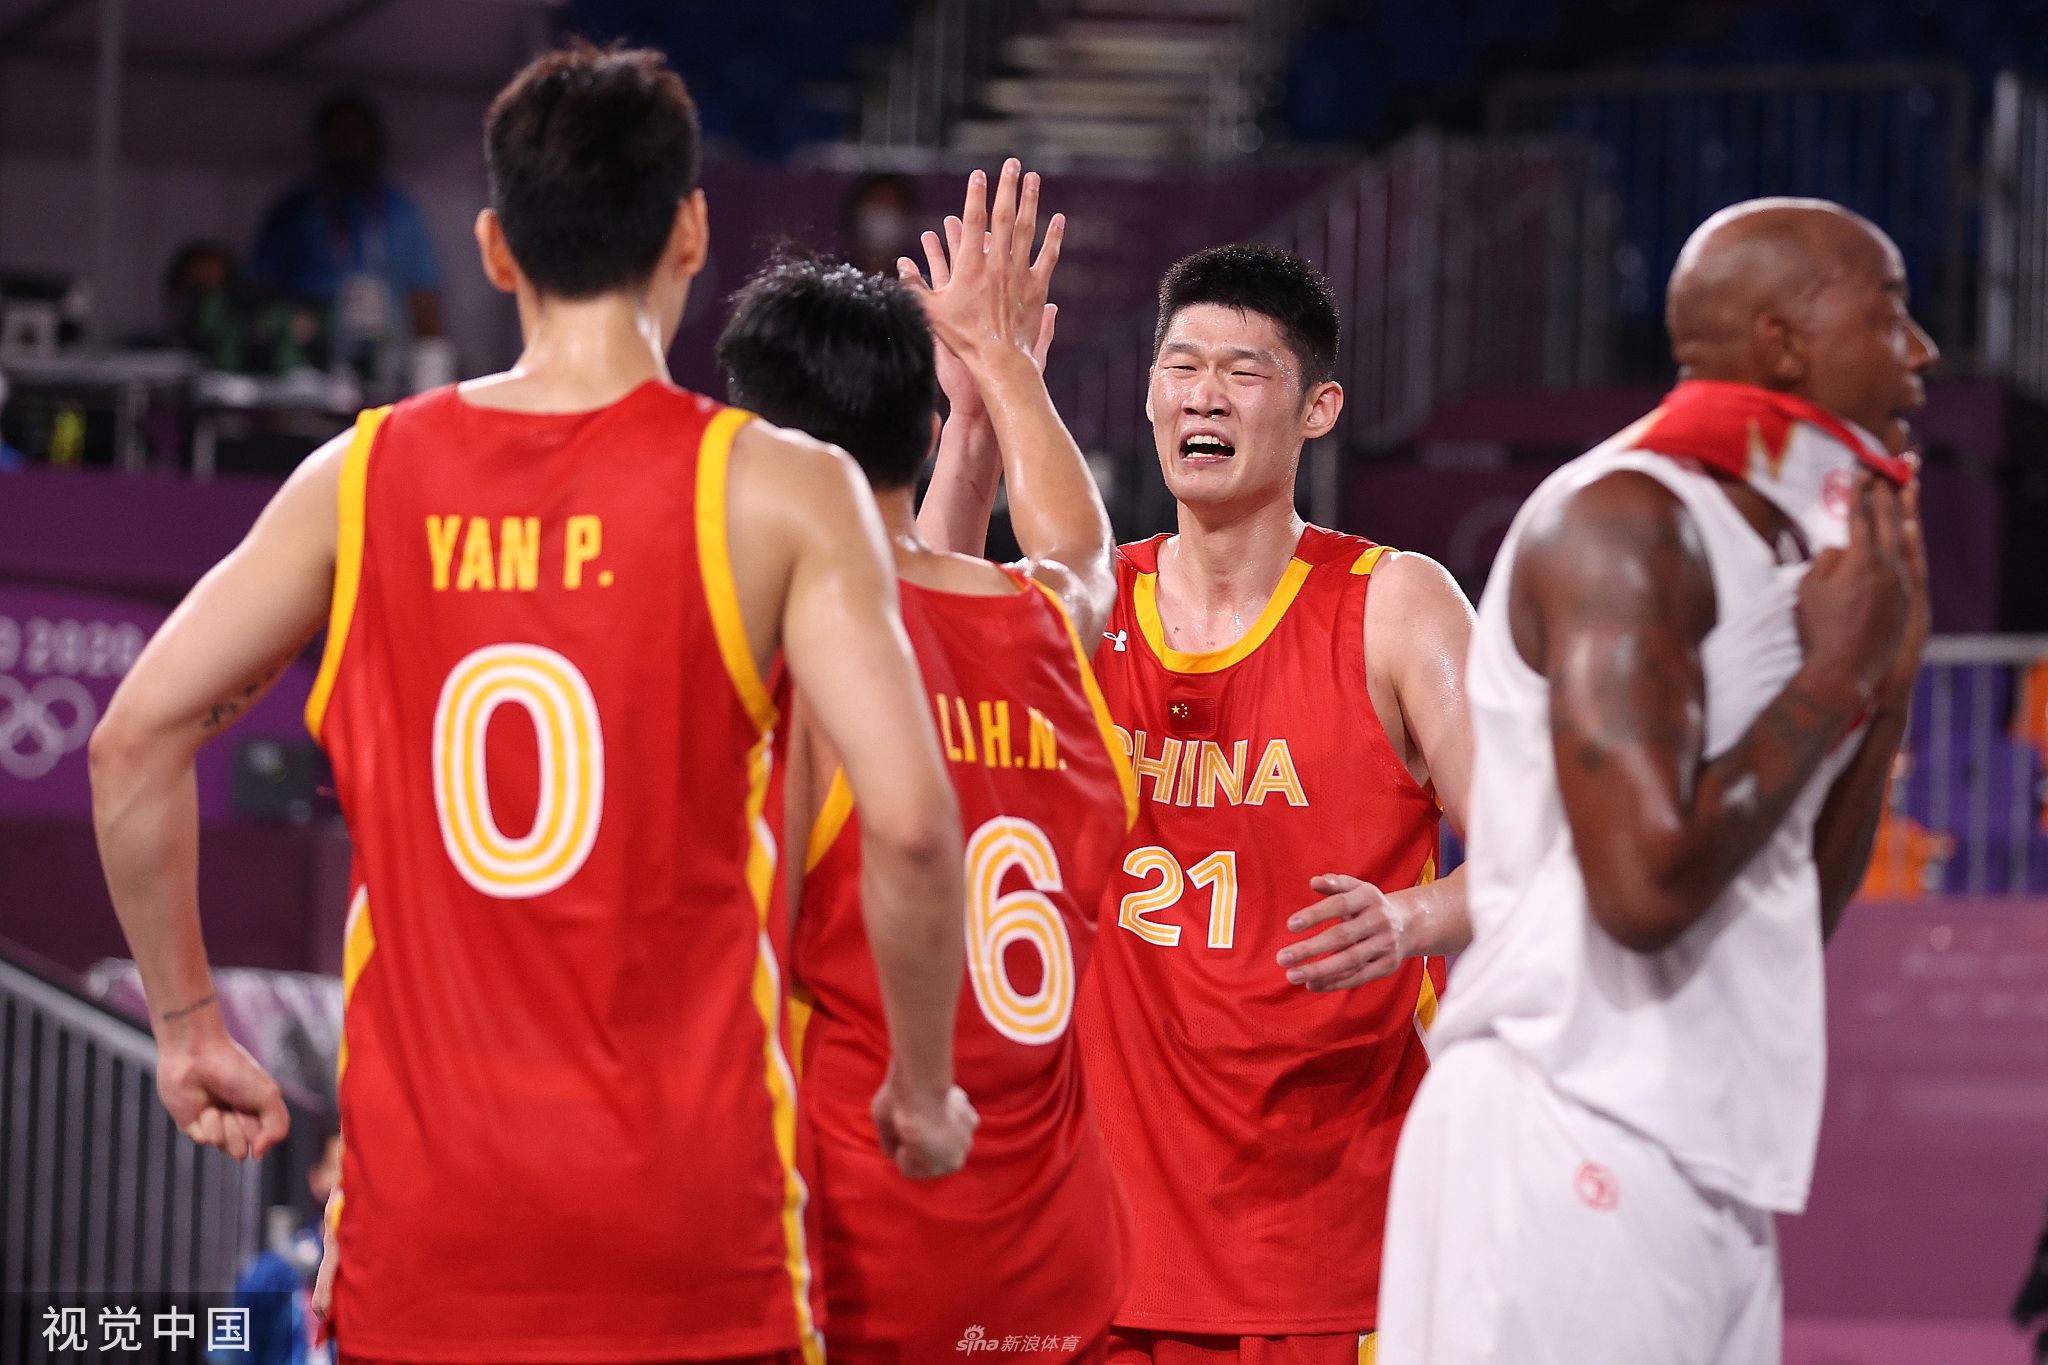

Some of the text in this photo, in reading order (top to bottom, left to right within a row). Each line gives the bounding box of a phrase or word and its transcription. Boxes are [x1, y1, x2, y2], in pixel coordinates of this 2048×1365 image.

[425, 514, 615, 592] YAN P.
[432, 642, 605, 899] 0
[964, 815, 1076, 1046] 6
[1118, 845, 1239, 949] 21
